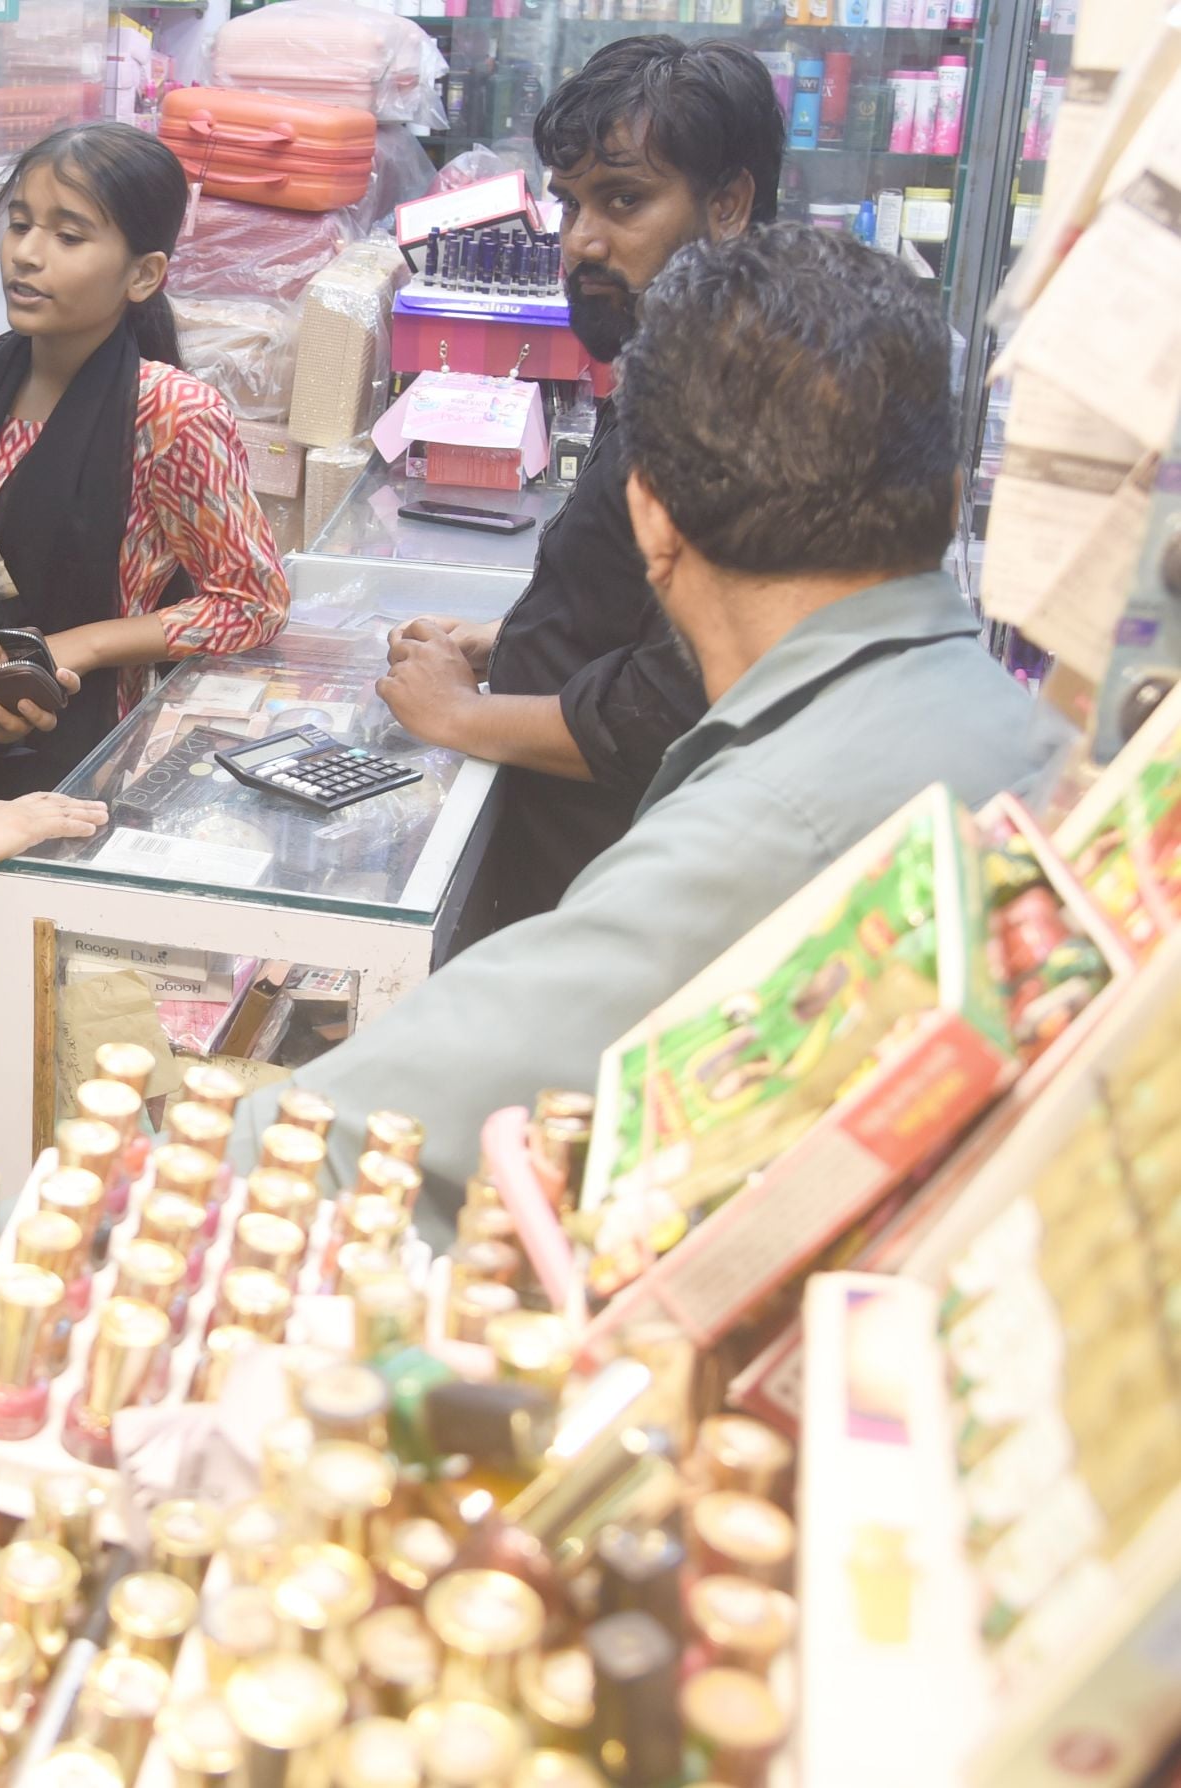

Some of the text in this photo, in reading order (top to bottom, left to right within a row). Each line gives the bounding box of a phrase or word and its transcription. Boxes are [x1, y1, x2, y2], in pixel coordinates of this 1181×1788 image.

[122, 753, 188, 805] GLOW
[75, 939, 119, 958] Raaga
[155, 979, 202, 995] Raaga
